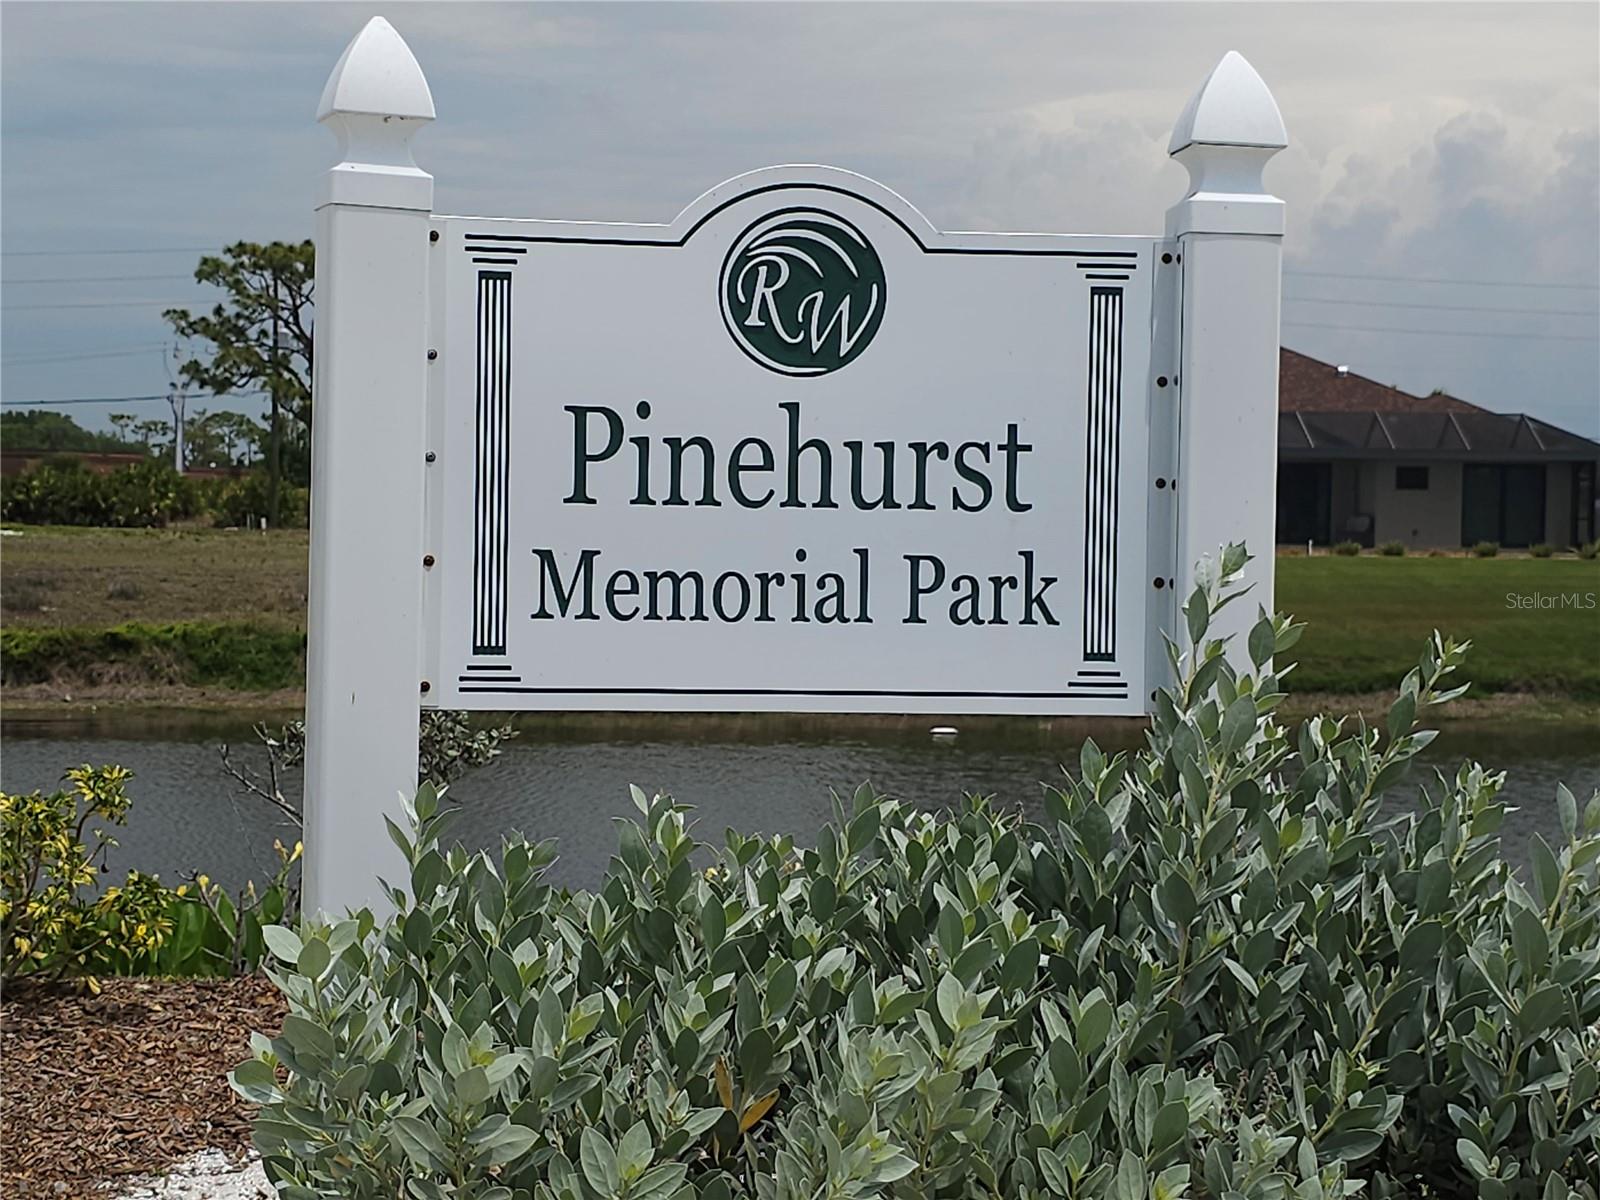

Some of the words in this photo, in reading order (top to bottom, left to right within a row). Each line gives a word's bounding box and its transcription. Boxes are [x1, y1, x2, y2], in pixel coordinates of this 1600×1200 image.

[736, 254, 879, 358] RW
[562, 400, 1033, 513] Pinehurst
[530, 547, 874, 624] Memorial
[902, 550, 1061, 626] Park
